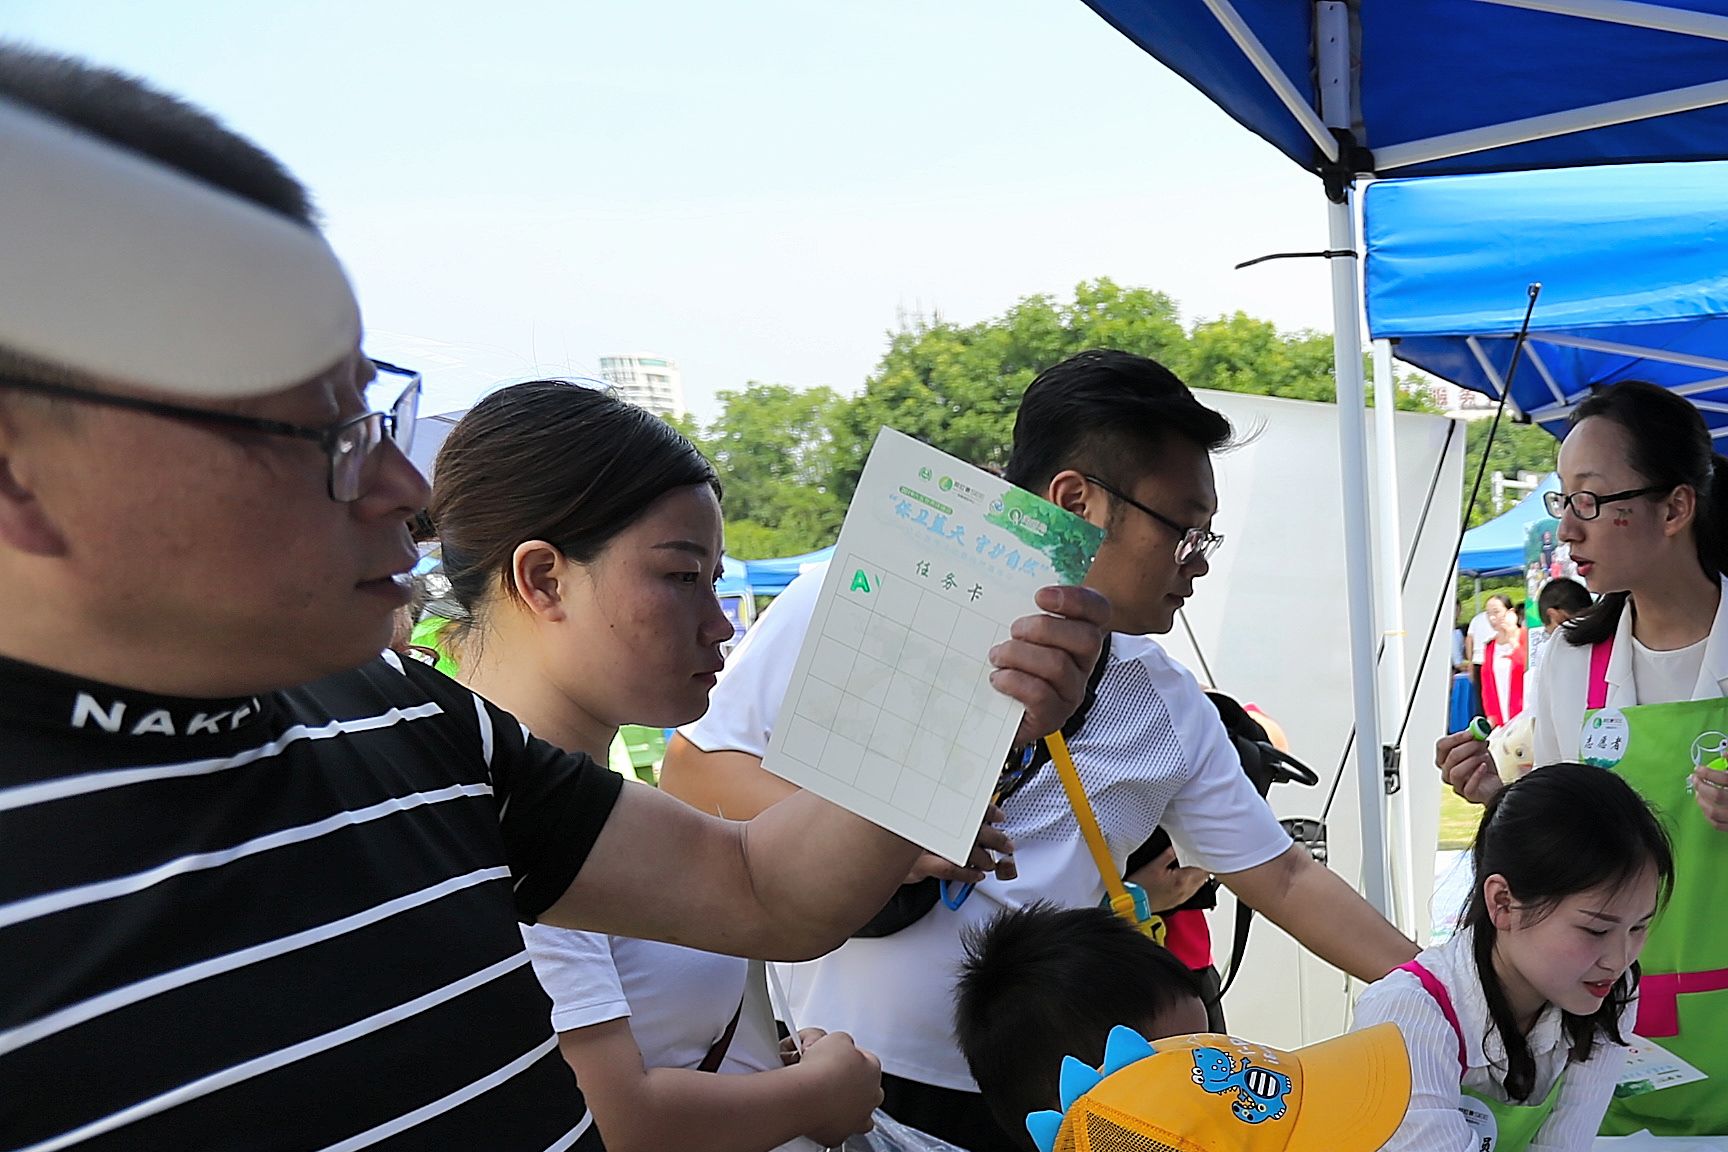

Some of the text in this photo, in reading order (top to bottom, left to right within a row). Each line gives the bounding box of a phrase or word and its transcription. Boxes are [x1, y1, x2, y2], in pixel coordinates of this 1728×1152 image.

[850, 568, 871, 593] A
[915, 559, 984, 602] 任务卡
[1584, 734, 1623, 751] 志愿者
